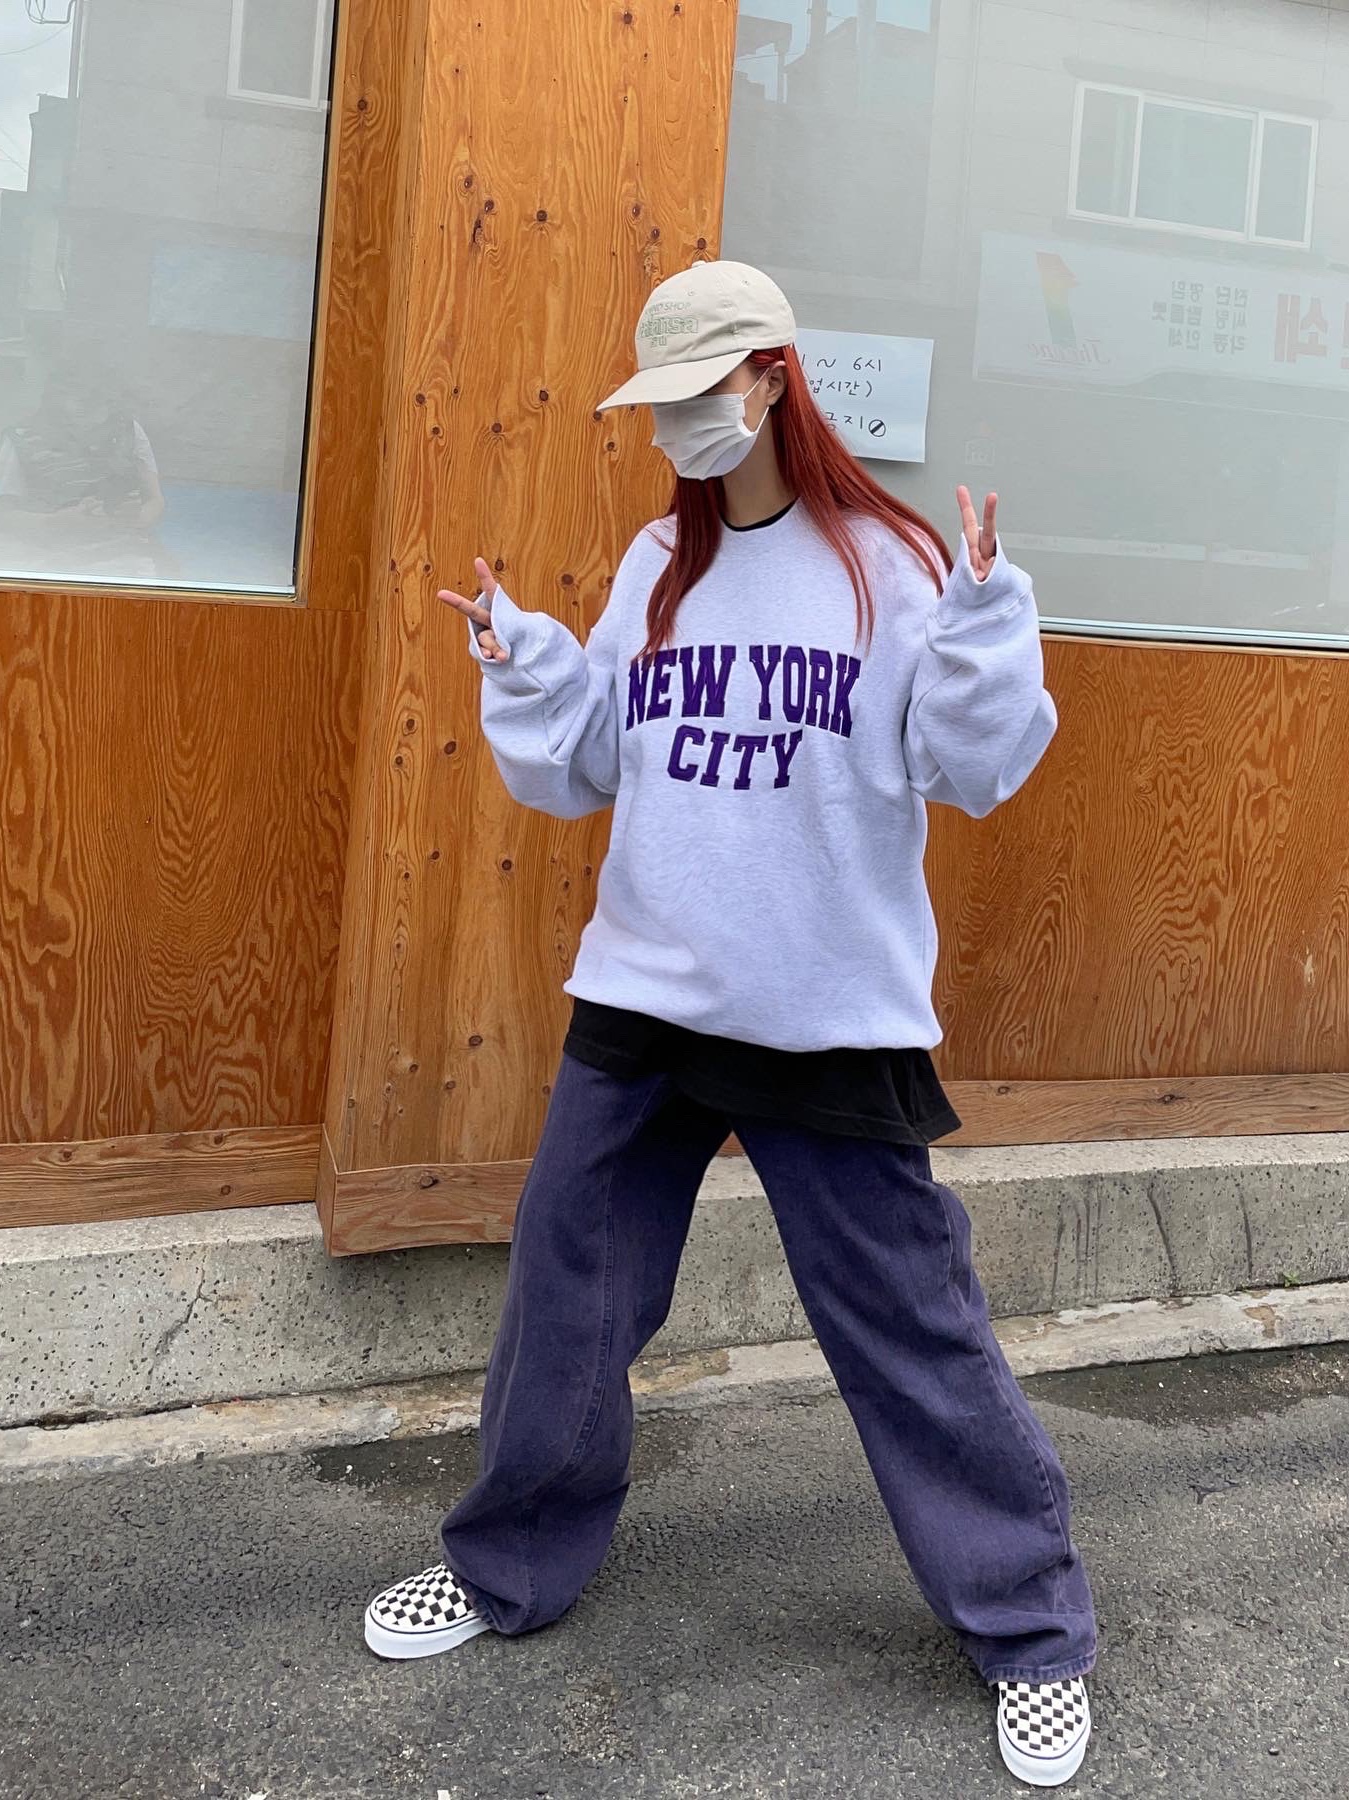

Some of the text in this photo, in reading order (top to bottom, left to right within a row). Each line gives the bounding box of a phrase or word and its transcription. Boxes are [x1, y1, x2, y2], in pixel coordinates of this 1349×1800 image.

[853, 356, 882, 372] 6시
[626, 645, 861, 738] NEW YORK
[667, 724, 803, 790] CITY
